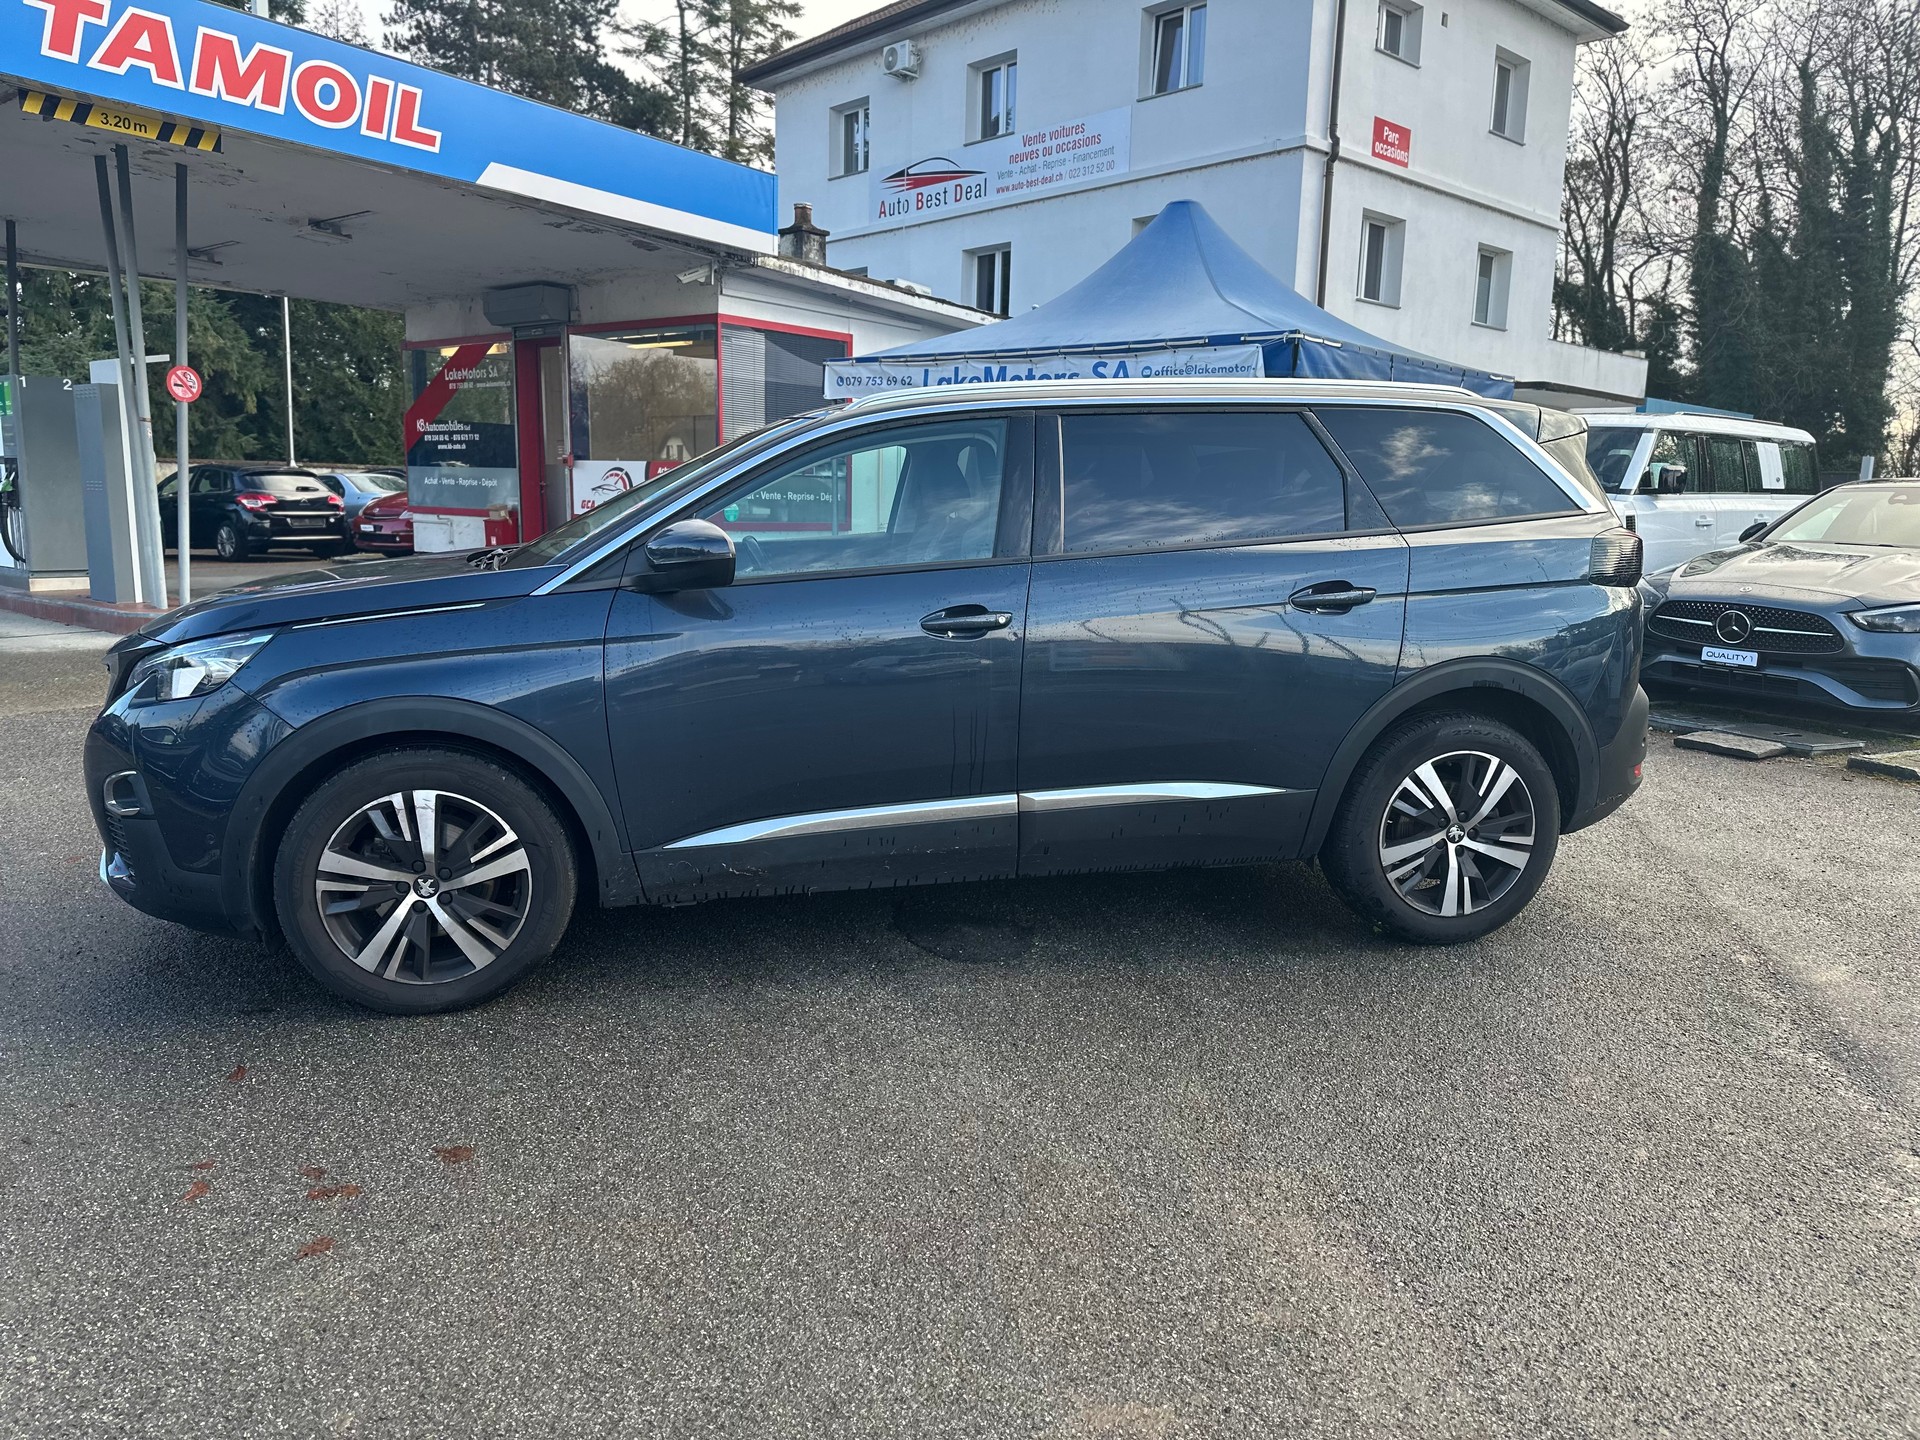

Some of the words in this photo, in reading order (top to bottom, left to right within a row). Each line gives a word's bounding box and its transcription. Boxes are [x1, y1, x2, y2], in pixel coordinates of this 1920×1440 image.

[22, 0, 443, 154] TAMOIL
[100, 112, 131, 130] 3.20
[133, 122, 148, 134] m
[1022, 133, 1047, 148] Vente
[1049, 122, 1086, 142] voitures
[1383, 126, 1400, 145] Parc
[1009, 148, 1040, 165] neuves
[1042, 146, 1053, 158] ou
[1055, 133, 1102, 154] occasions
[1374, 141, 1409, 163] occasions
[997, 169, 1014, 181] Vente
[1019, 164, 1037, 176] Achat
[1042, 157, 1067, 170] Reprise
[1072, 145, 1115, 164] Financement
[996, 173, 1064, 195] www.auto-best-deal.ch
[1068, 167, 1081, 180] 022
[1082, 164, 1094, 177] 312
[1096, 162, 1104, 174] 52
[1106, 159, 1115, 172] 00
[878, 197, 910, 219] Auto
[916, 186, 948, 211] Best
[954, 177, 987, 203] Deal
[444, 367, 487, 381] LakeMotors
[488, 364, 498, 378] SA
[1092, 360, 1130, 379] SA
[19, 376, 27, 388] 1
[62, 379, 73, 391] 2
[845, 376, 863, 387] 079
[865, 375, 883, 386] 753
[886, 376, 898, 386] 69
[900, 375, 913, 386] 62
[424, 476, 438, 485] Achat
[441, 477, 455, 485] Vente
[458, 477, 478, 487] Reprise
[581, 499, 596, 509] GCA
[760, 491, 781, 500] Vente
[787, 491, 815, 502] Reprise
[820, 492, 841, 503] Dépt
[1706, 650, 1748, 662] QUALITY
